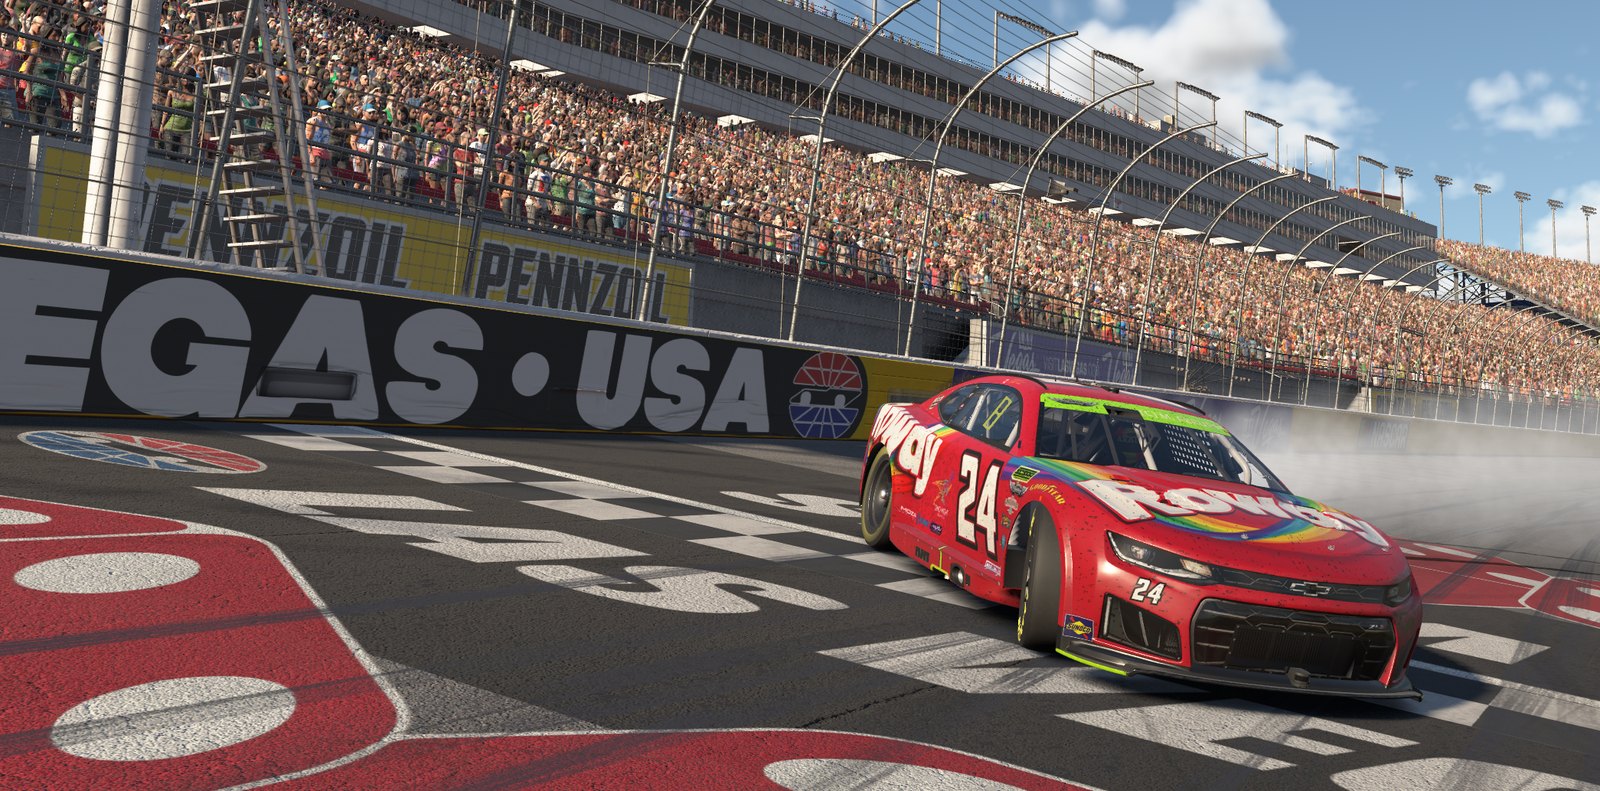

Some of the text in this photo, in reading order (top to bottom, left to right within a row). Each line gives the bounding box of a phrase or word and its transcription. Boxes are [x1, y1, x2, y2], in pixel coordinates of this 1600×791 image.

[138, 181, 412, 289] ENNZOIL
[475, 242, 668, 323] PENNZOL
[0, 256, 770, 433] EGAS USA
[957, 449, 1003, 561] 24
[1030, 484, 1066, 504] GOODYEAR
[1066, 621, 1092, 635] SUNOCO
[1130, 578, 1165, 605] 24
